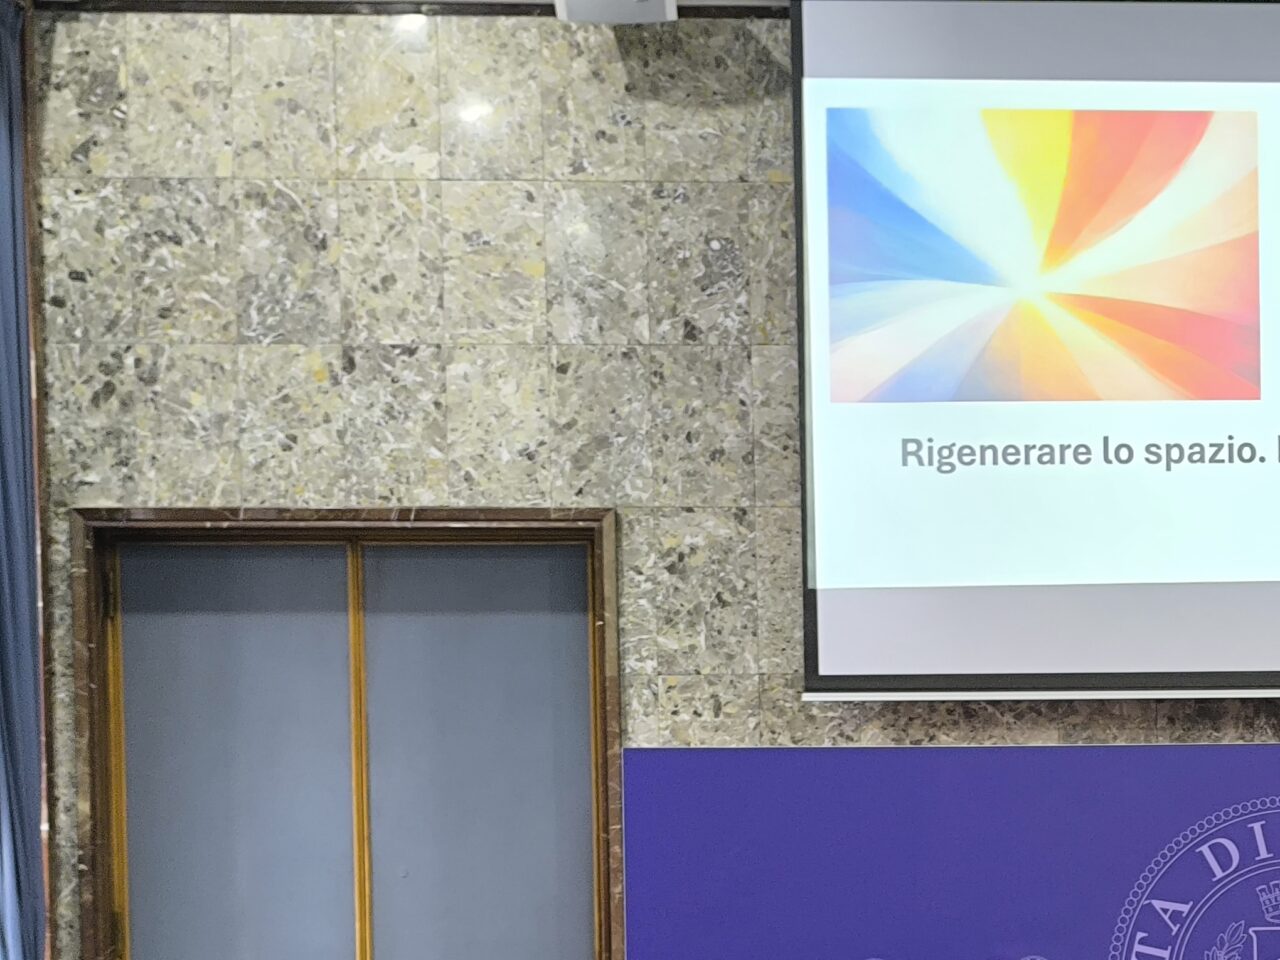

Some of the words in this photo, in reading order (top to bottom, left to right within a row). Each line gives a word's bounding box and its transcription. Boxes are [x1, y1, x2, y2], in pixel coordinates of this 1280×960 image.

[901, 437, 1092, 474] Rigenerare
[1102, 435, 1134, 465] lo
[1144, 434, 1266, 472] spazio.
[1195, 820, 1274, 882] DI
